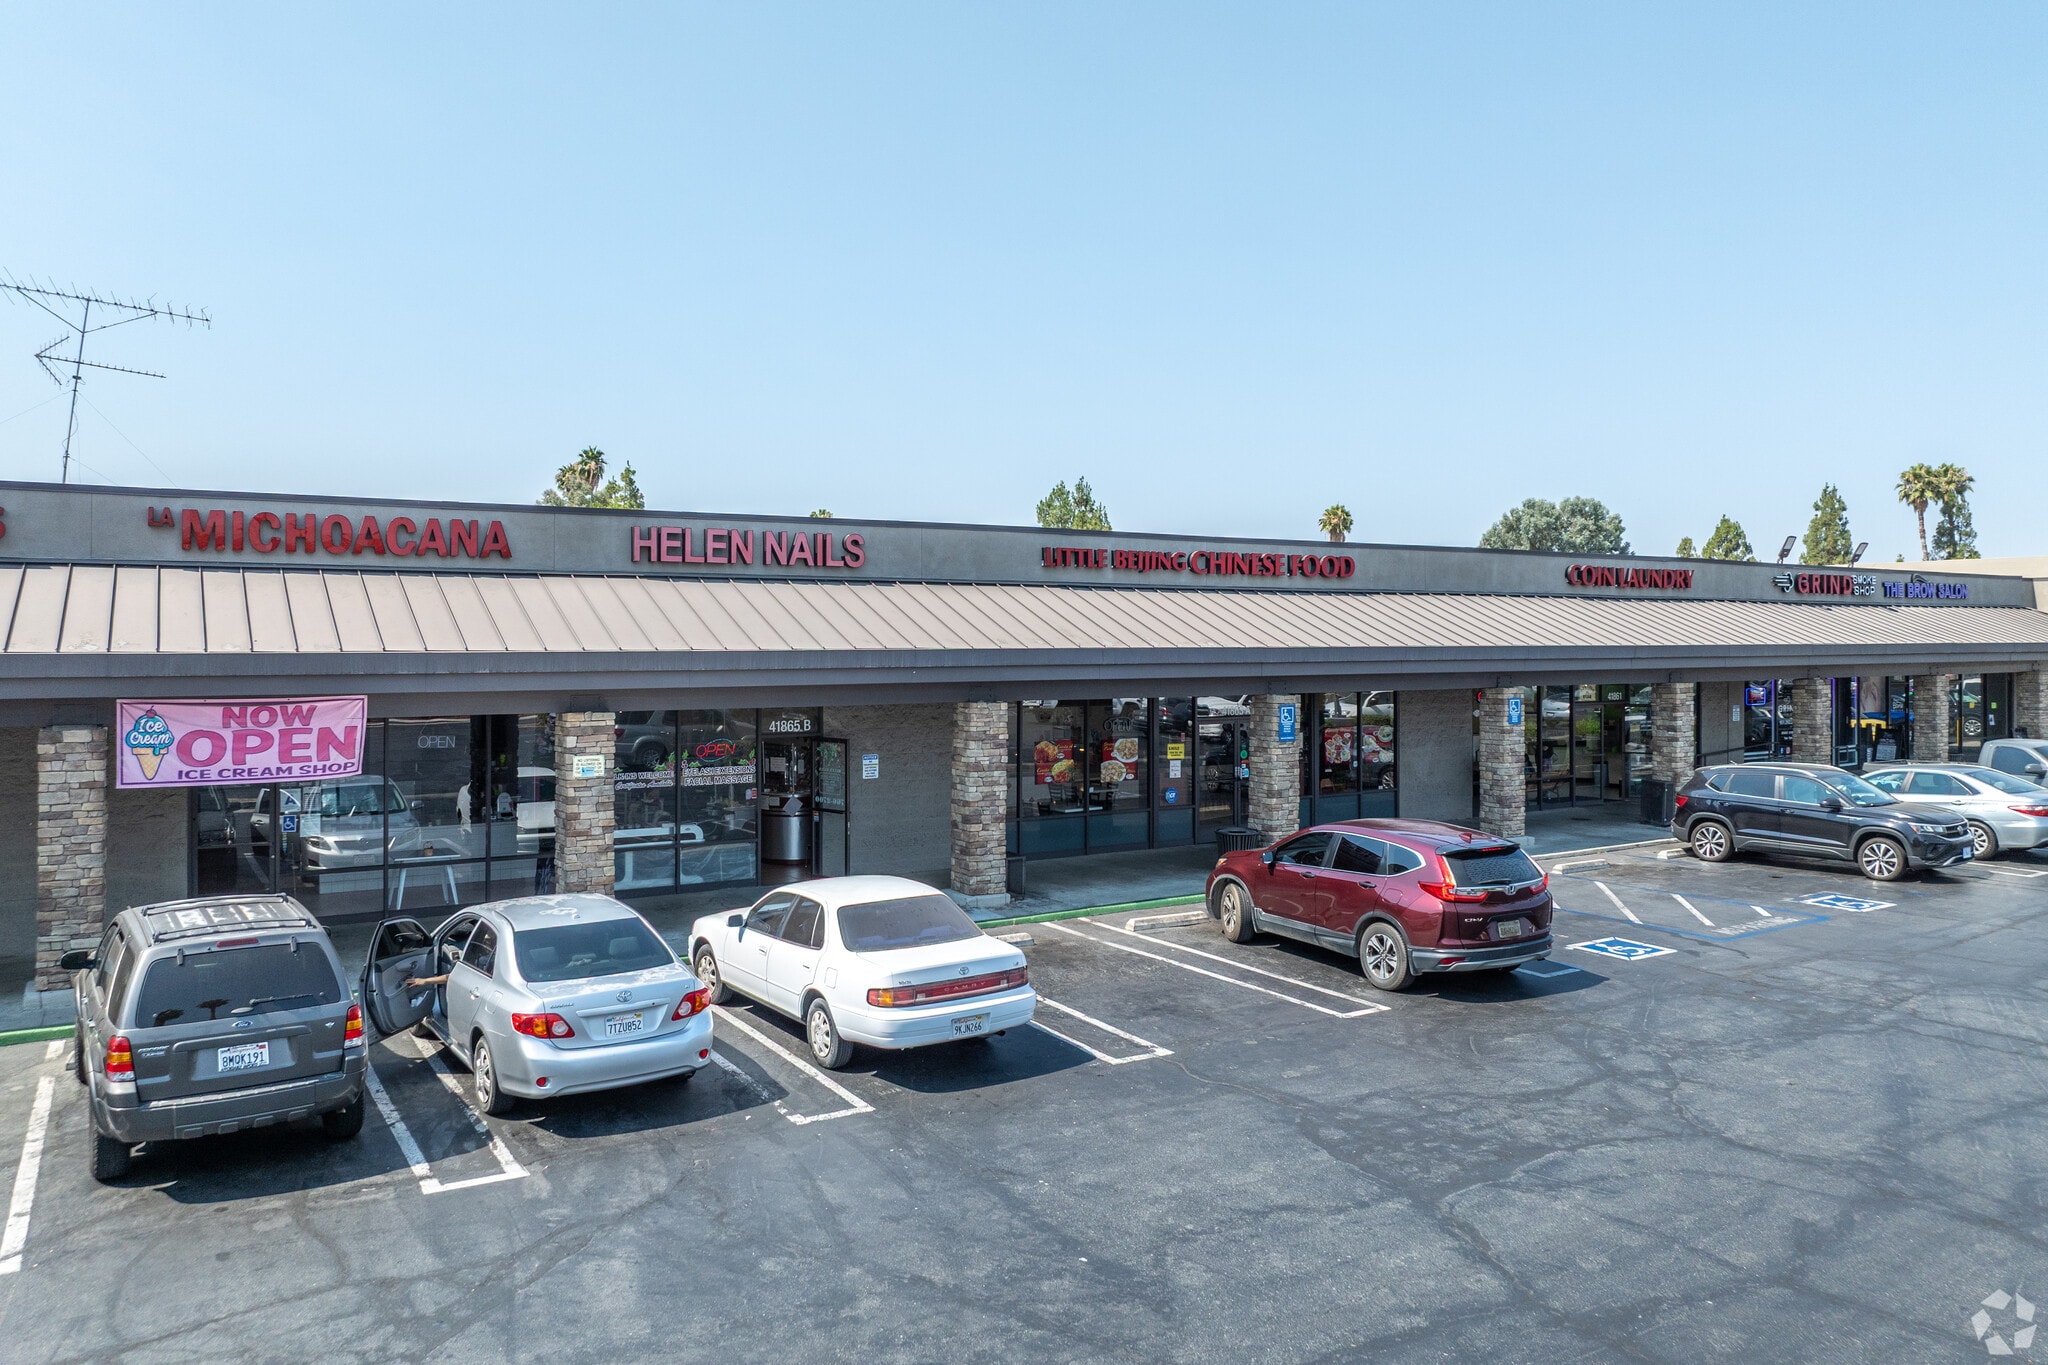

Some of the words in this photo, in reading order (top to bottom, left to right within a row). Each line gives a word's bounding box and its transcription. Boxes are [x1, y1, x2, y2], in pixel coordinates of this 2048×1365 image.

[147, 506, 174, 527] LA
[181, 508, 512, 559] MICHOACANA
[631, 525, 754, 564] HELEN
[764, 530, 866, 568] NAILS
[1041, 546, 1108, 568] LITTLE
[1111, 549, 1187, 573] BEIJING
[1188, 550, 1286, 576] CHINESE
[1288, 554, 1356, 578] FOOD
[1565, 564, 1616, 587] COIN
[1618, 567, 1695, 589] LAUNDRY
[1798, 573, 1852, 595] GRIND
[1852, 574, 1877, 585] SMOKE
[1853, 585, 1876, 596] SHOP
[1883, 581, 1904, 598] THE
[1907, 582, 1936, 599] BROW
[1937, 583, 1968, 599] SALON
[222, 705, 318, 729] NOW
[138, 718, 164, 733] Ice
[769, 720, 801, 732] 41865
[803, 719, 811, 731] B
[129, 732, 172, 746] Cream
[176, 725, 358, 768] OPEN
[417, 735, 456, 749] OPEN
[696, 743, 736, 758] OPEN
[177, 768, 212, 780] ICE
[218, 765, 294, 778] CREAM
[299, 761, 356, 775] SHOP
[638, 771, 674, 779] WELCOME
[684, 776, 713, 786] FACIAL
[714, 775, 754, 785] MASSAGE
[608, 1020, 642, 1034] 7TZU852
